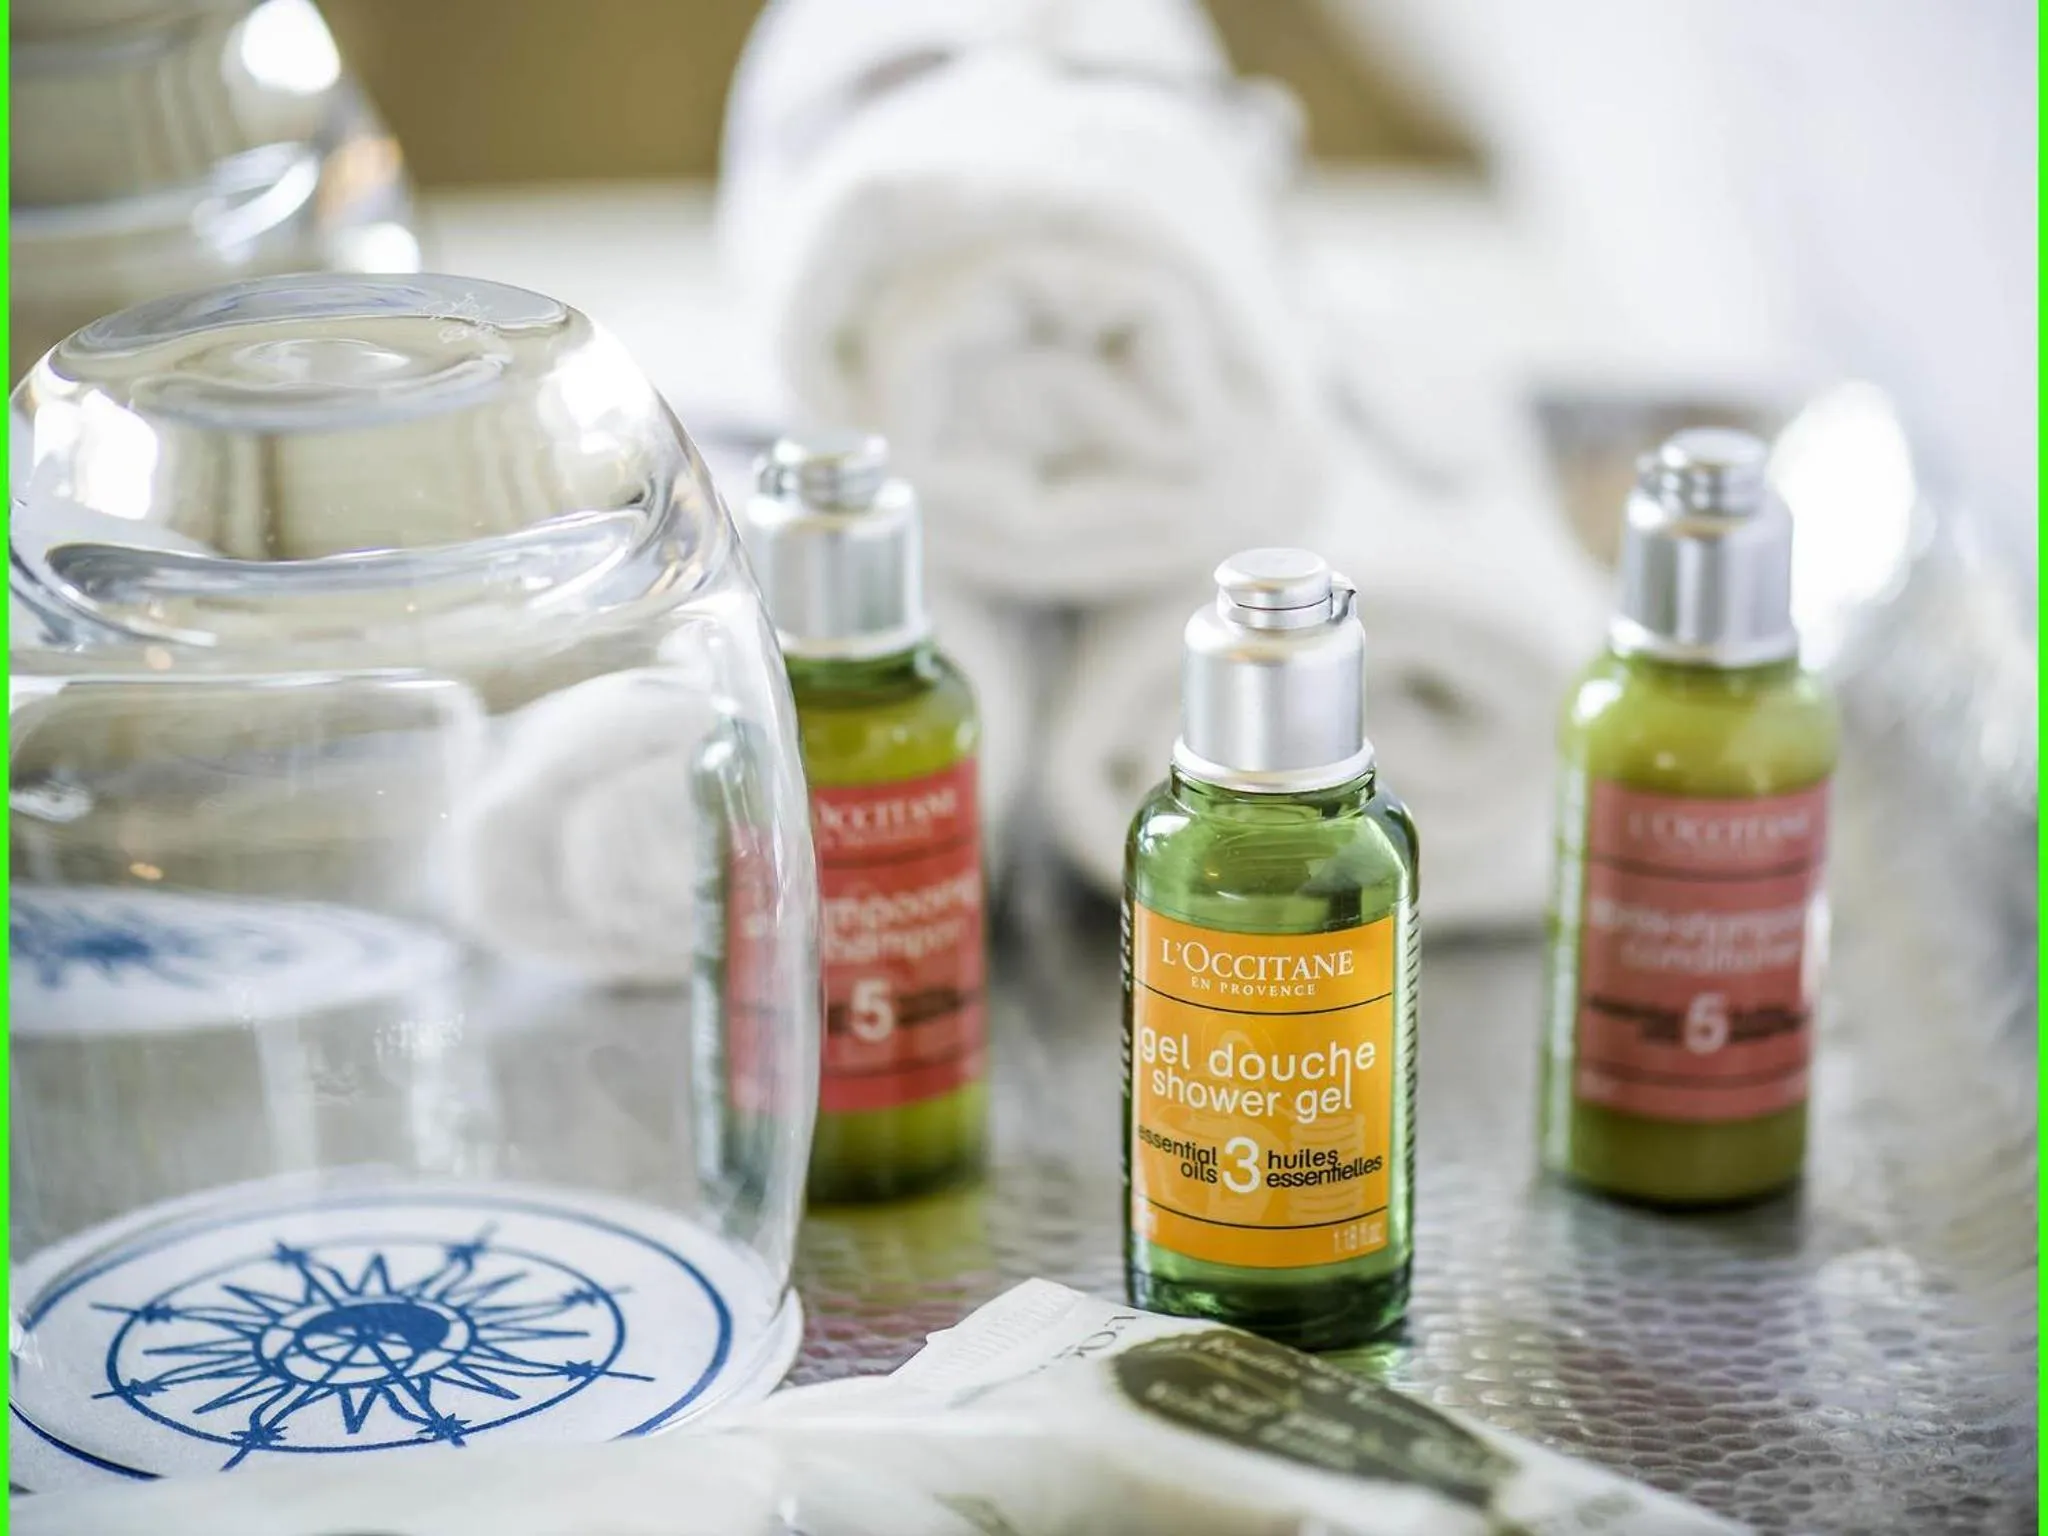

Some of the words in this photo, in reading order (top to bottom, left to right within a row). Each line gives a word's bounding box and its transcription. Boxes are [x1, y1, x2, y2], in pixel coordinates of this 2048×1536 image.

[1160, 937, 1355, 982] L'OCCITANE
[1191, 975, 1211, 990] EN
[1220, 980, 1316, 998] PROVENCE
[852, 977, 895, 1042] 5
[1139, 1026, 1191, 1070] gel
[1208, 1040, 1377, 1083] douche
[1152, 1066, 1282, 1117] shower
[1295, 1066, 1353, 1124] gel
[1138, 1124, 1218, 1166] essential
[1222, 1135, 1262, 1194] 3
[1267, 1149, 1339, 1170] huiles
[1180, 1157, 1218, 1184] oils
[1266, 1153, 1383, 1188] essentielles
